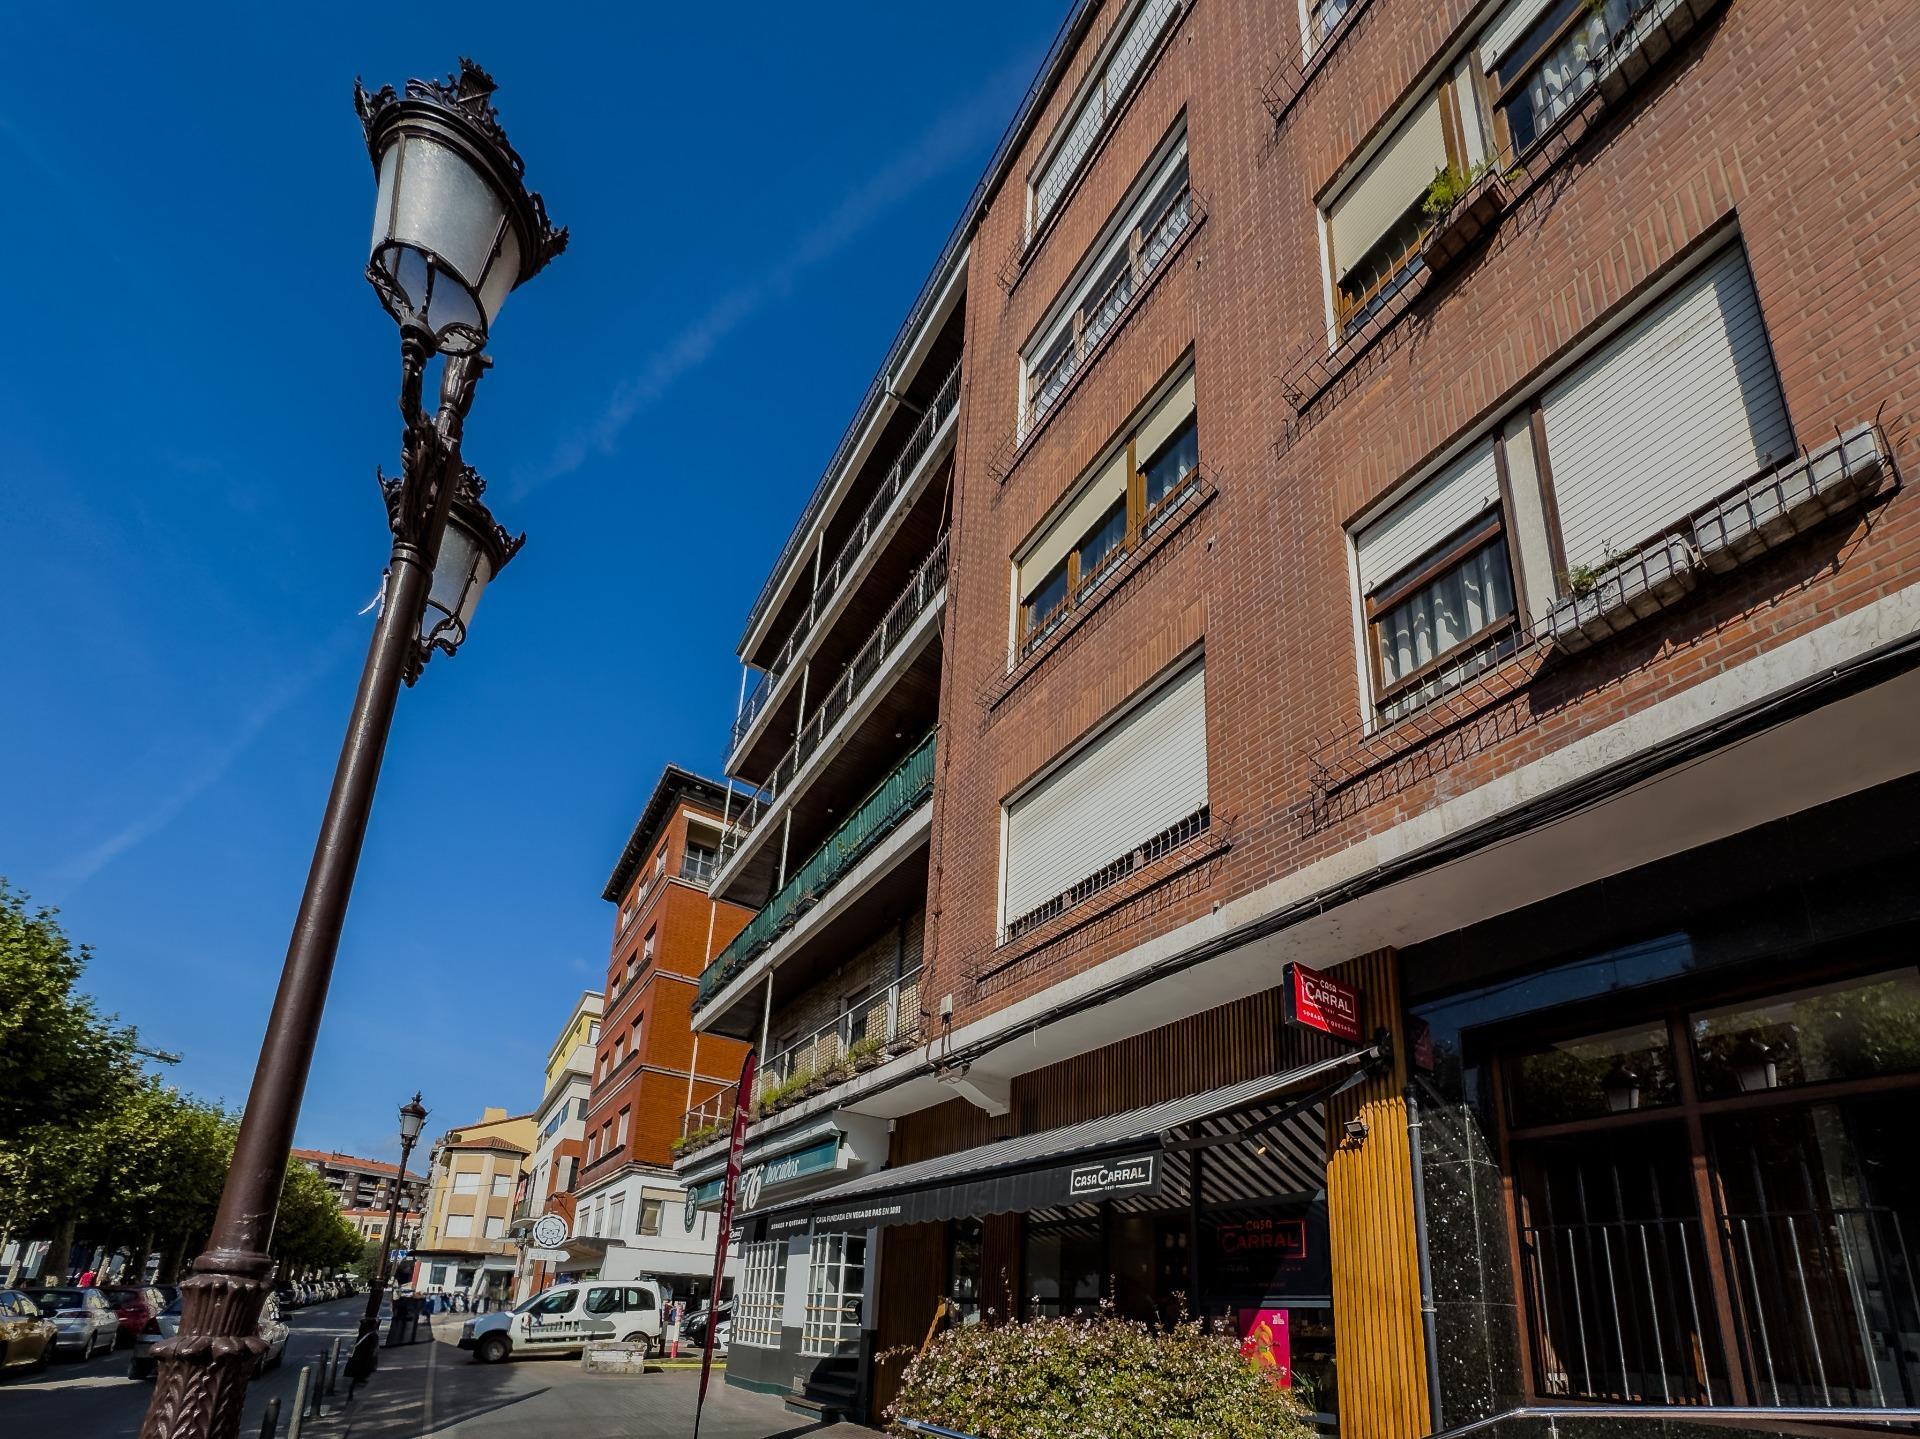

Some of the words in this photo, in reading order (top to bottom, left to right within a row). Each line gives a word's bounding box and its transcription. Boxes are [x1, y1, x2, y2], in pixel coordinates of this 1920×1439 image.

[1319, 980, 1337, 993] CASA
[1304, 981, 1353, 1014] CARRAL
[742, 1163, 765, 1212] 76
[1074, 1174, 1097, 1188] CASA
[1097, 1167, 1146, 1185] CARRAL
[845, 1212, 852, 1220] EN
[864, 1209, 871, 1218] DE
[1245, 1219, 1273, 1231] CASA
[1222, 1231, 1299, 1253] CARRAL
